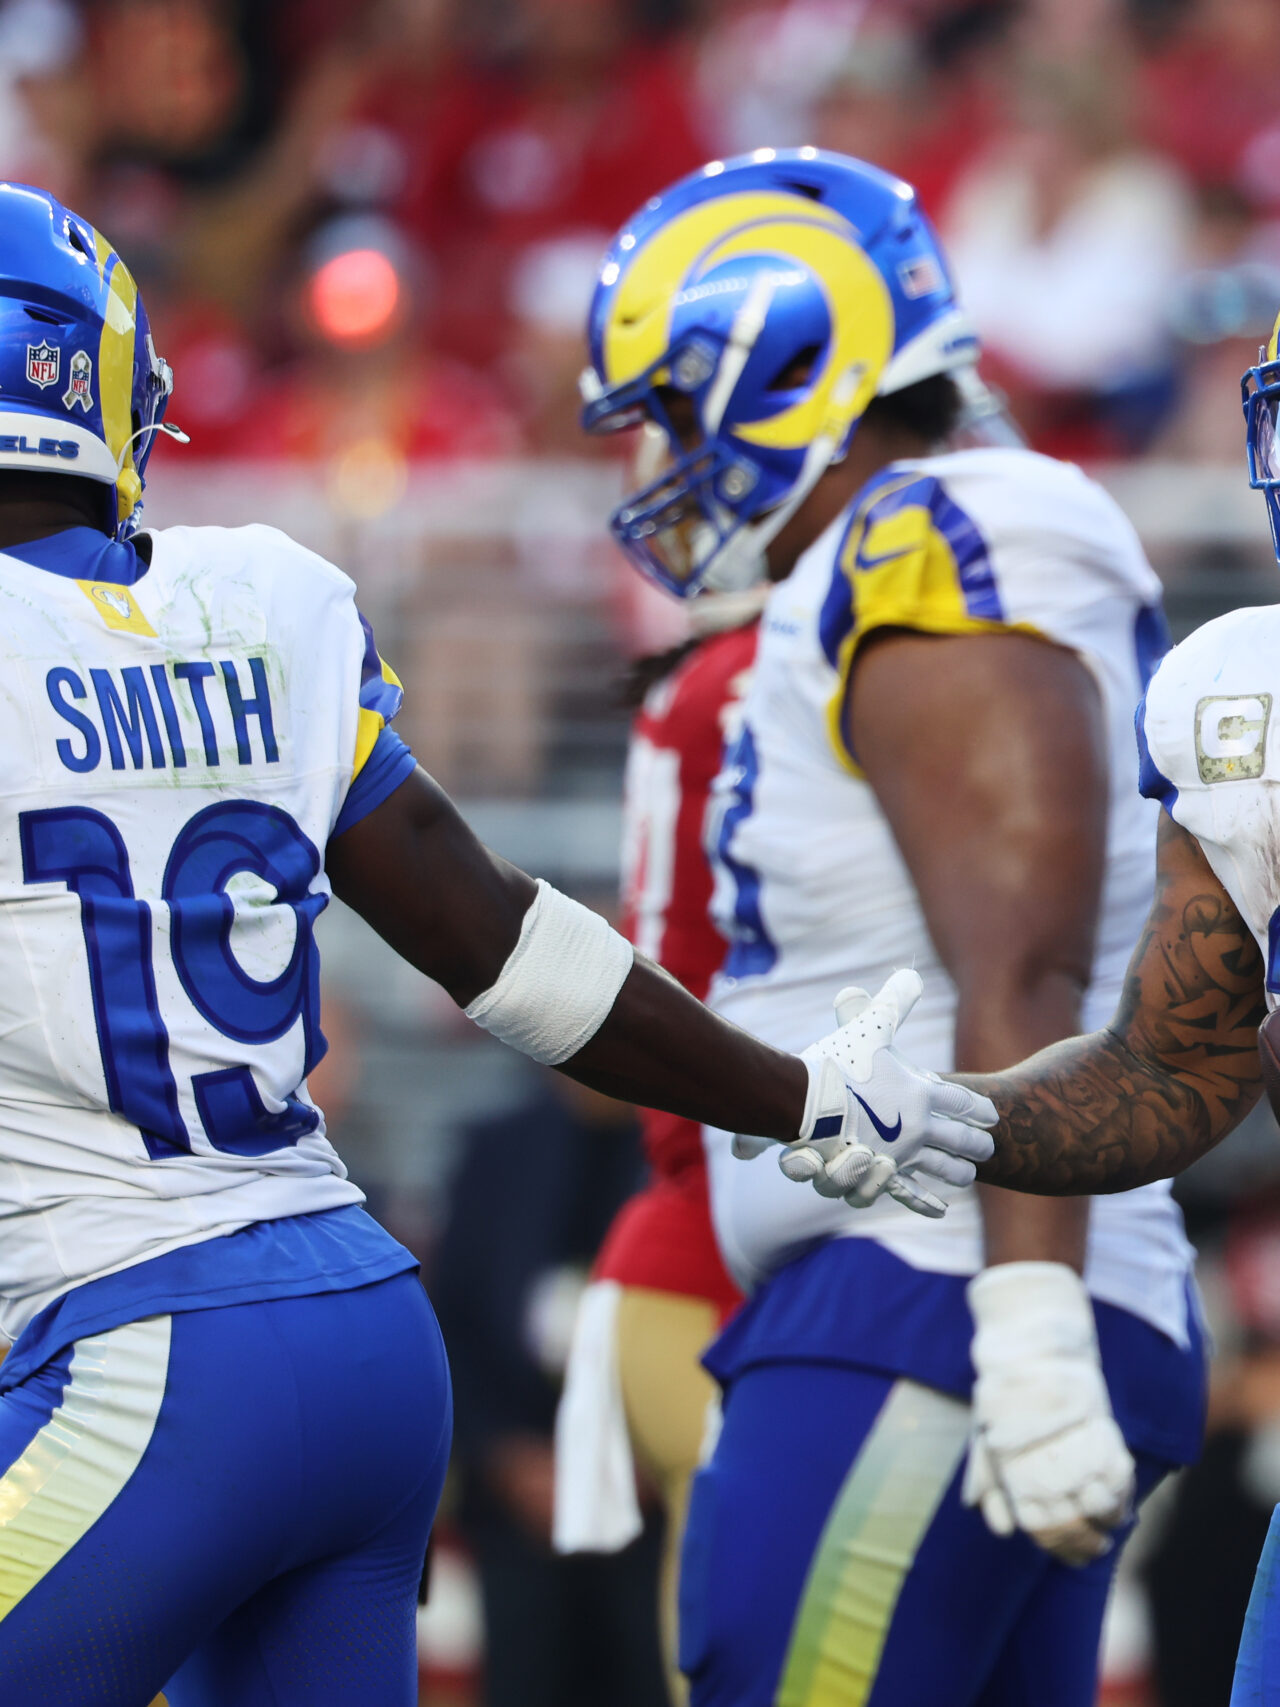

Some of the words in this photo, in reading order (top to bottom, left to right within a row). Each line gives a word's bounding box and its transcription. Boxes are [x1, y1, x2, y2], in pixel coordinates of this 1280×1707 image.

[31, 361, 55, 382] NFL
[73, 379, 88, 395] NFL
[45, 656, 281, 774] SMITH
[1200, 698, 1265, 759] C
[18, 799, 330, 1161] 19
